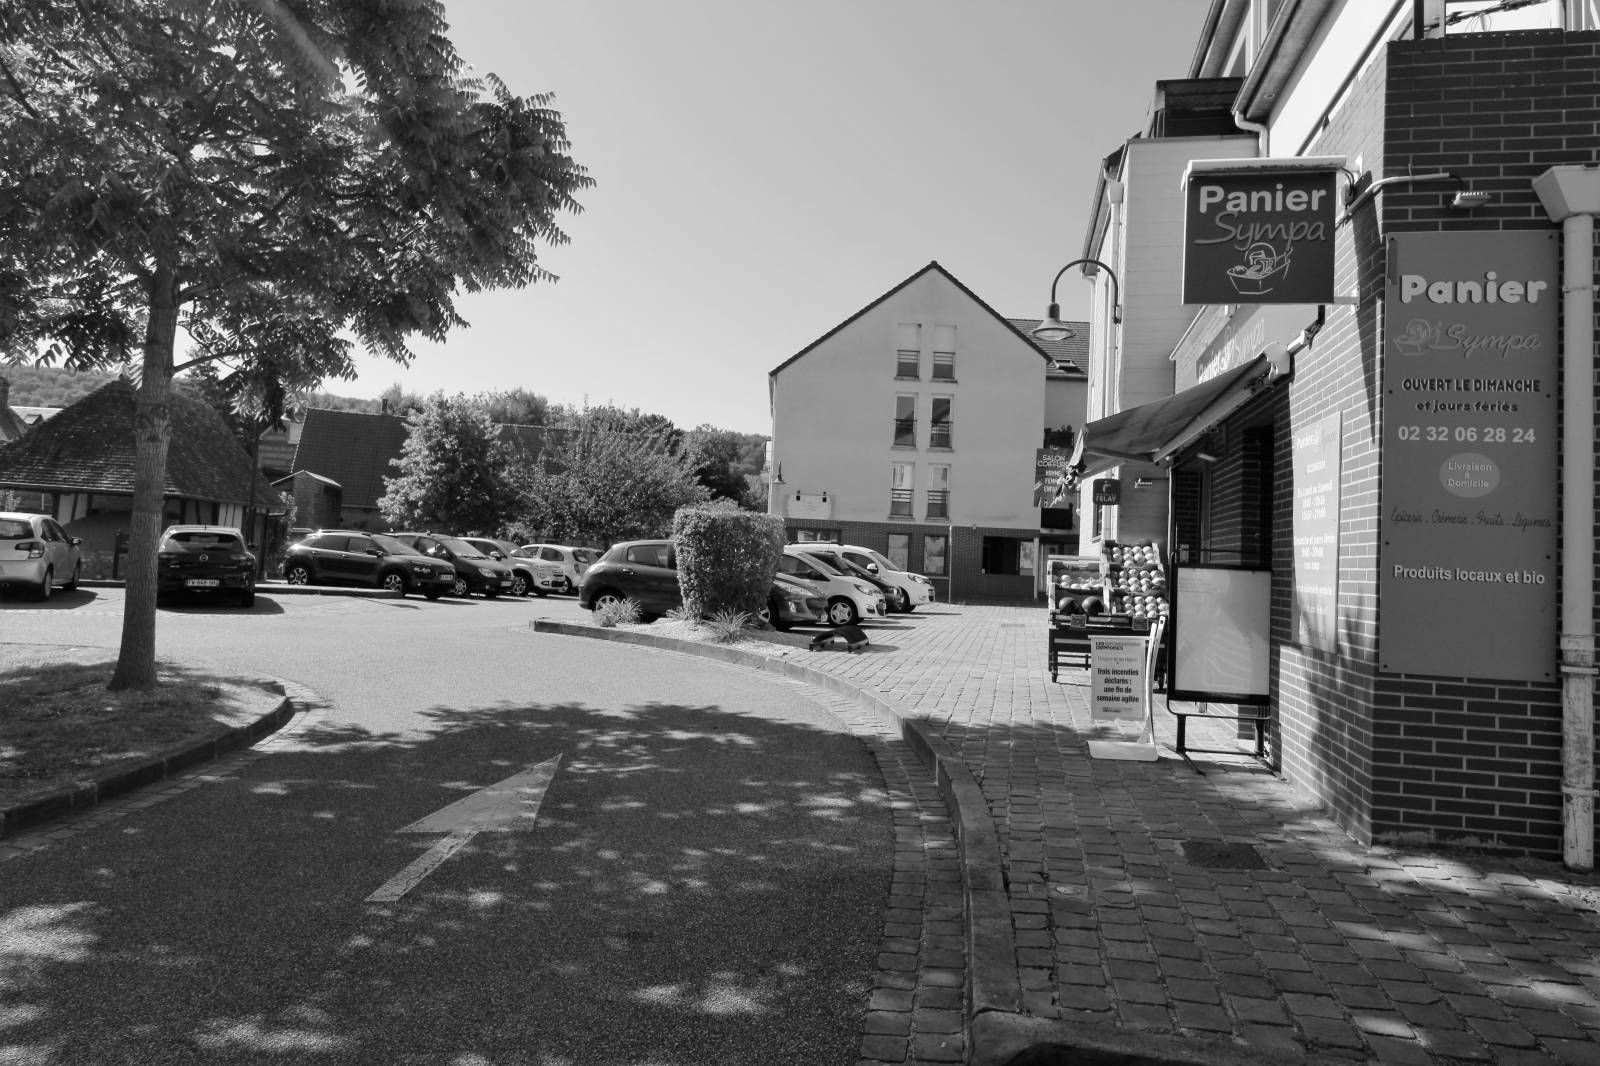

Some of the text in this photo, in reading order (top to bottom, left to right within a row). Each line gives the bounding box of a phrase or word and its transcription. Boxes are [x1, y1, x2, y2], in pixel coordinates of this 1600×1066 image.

[1200, 183, 1327, 214] Panier
[1194, 210, 1326, 251] Sympa
[1401, 271, 1548, 304] Panier
[1427, 324, 1542, 359] Sympa
[1402, 378, 1541, 393] OUVERT LE DIMANCHE
[1416, 401, 1431, 410] et
[1433, 401, 1471, 413] jours
[1398, 426, 1536, 443] 02 32 06 28 24
[1448, 462, 1492, 471] Livraison
[1447, 478, 1489, 488] Domicile
[1393, 565, 1545, 585] Produits locaux et bio
[1097, 667, 1139, 676] Trois incendies
[1104, 676, 1128, 684] déclarés
[1124, 686, 1132, 694] de
[1096, 694, 1139, 704] semaine agitée
